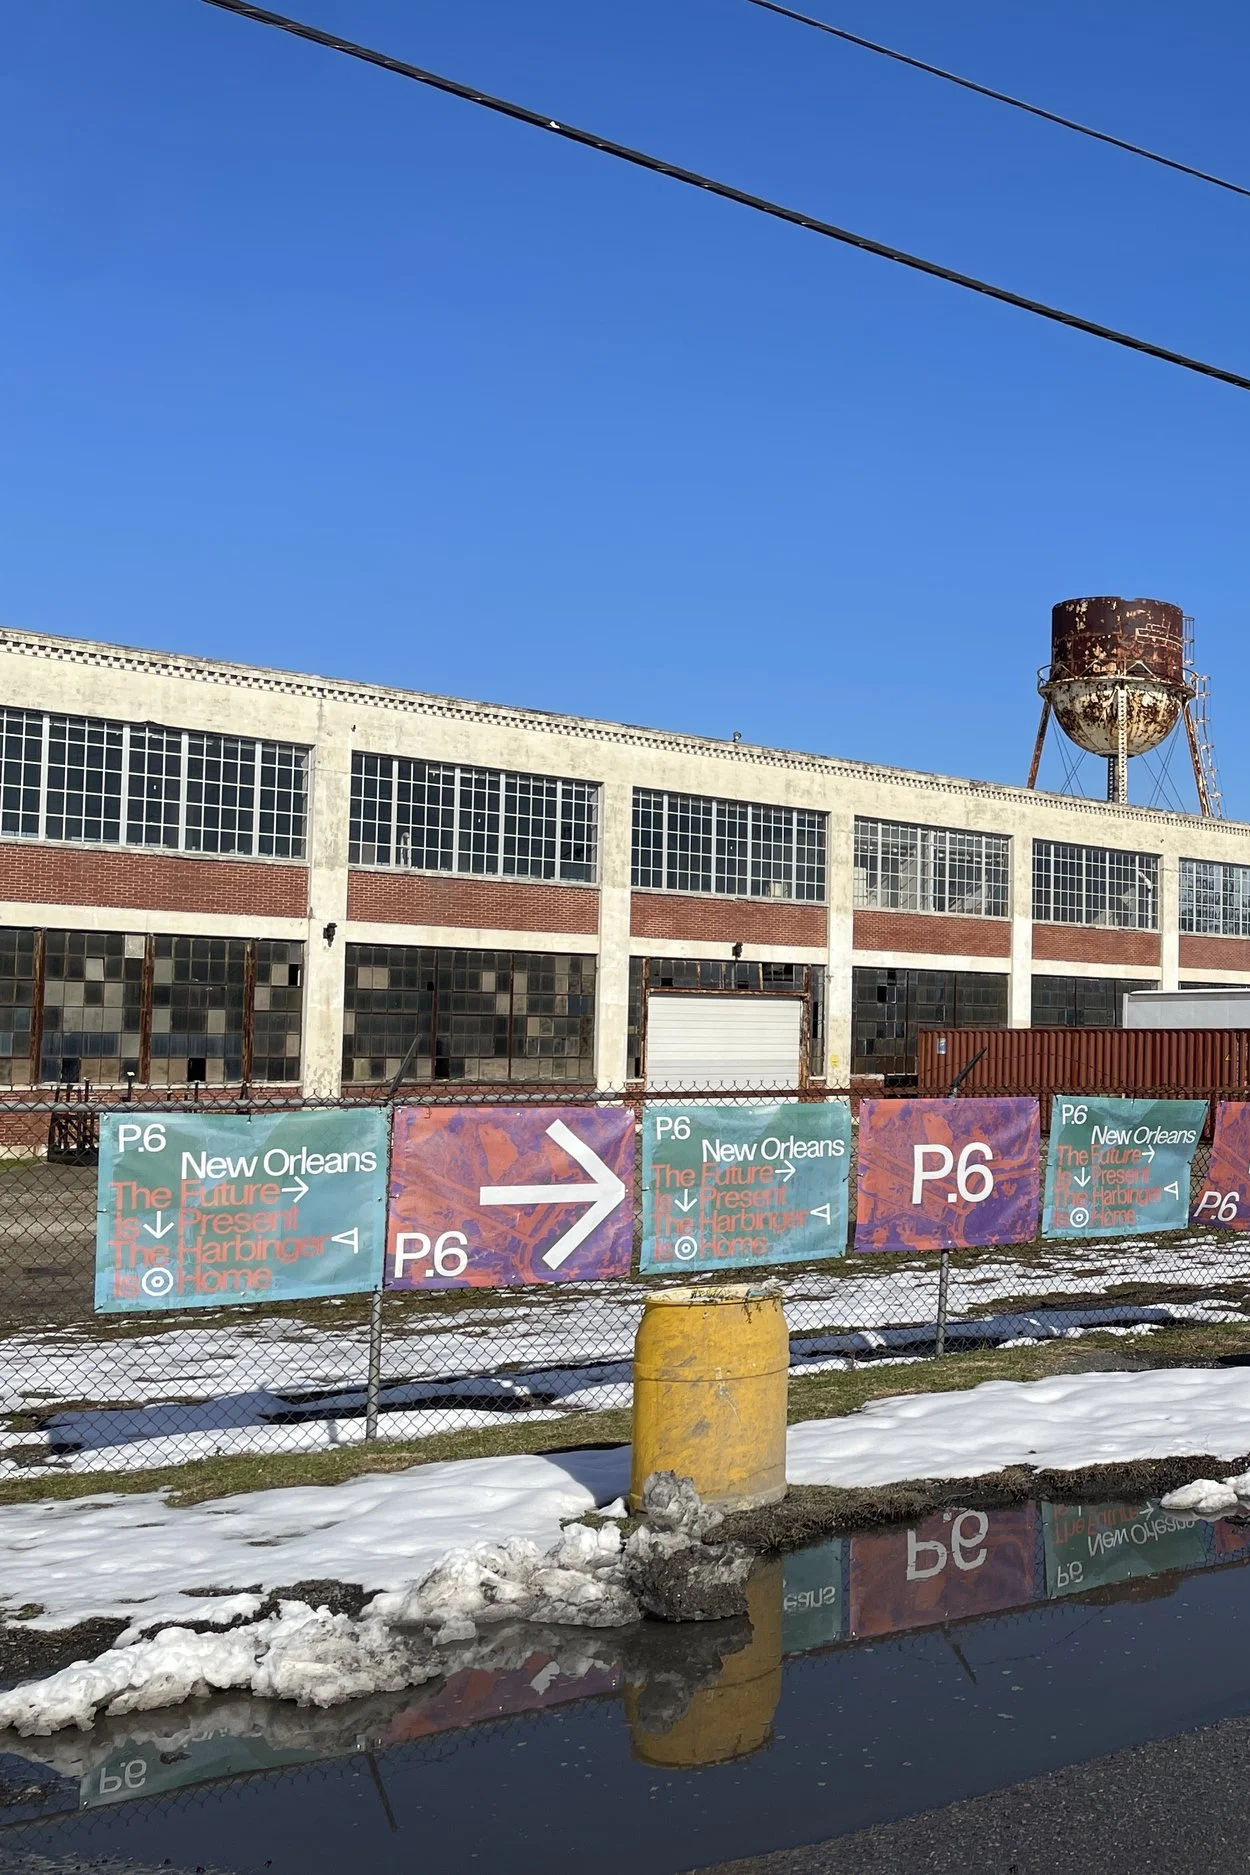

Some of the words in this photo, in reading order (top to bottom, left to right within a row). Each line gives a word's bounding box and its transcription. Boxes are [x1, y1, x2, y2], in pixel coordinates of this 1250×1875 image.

[656, 1116, 691, 1140] P.6
[1062, 1104, 1088, 1125] P.6
[118, 1124, 166, 1152] P.6
[702, 1138, 757, 1163] New
[760, 1135, 845, 1161] Orleans
[1091, 1125, 1132, 1145] New
[1133, 1126, 1196, 1144] Orleans
[181, 1151, 258, 1180] New
[264, 1147, 377, 1176] Orleans
[1056, 1145, 1089, 1165] The
[1091, 1144, 1143, 1165] Future
[652, 1164, 696, 1188] The
[701, 1163, 775, 1186] Future
[911, 1142, 994, 1205] P.6
[1056, 1167, 1072, 1187] Is
[1091, 1165, 1151, 1185] Present
[109, 1180, 172, 1210] The
[181, 1179, 281, 1209] Future
[655, 1189, 673, 1213] Is
[700, 1186, 787, 1210] Present
[1053, 1186, 1088, 1207] The
[1092, 1185, 1163, 1207] Harbinger
[1193, 1191, 1240, 1221] P.6
[114, 1212, 141, 1240] Is
[178, 1206, 299, 1237] Present
[652, 1212, 695, 1236] The
[700, 1208, 811, 1233] Harbinger
[1090, 1209, 1137, 1227] Home
[108, 1239, 170, 1269] The
[177, 1233, 331, 1267] Harbinger
[394, 1231, 468, 1279] P.6
[654, 1237, 673, 1261] Is
[700, 1234, 768, 1259] Home
[114, 1268, 140, 1298] Is
[177, 1266, 273, 1295] Home
